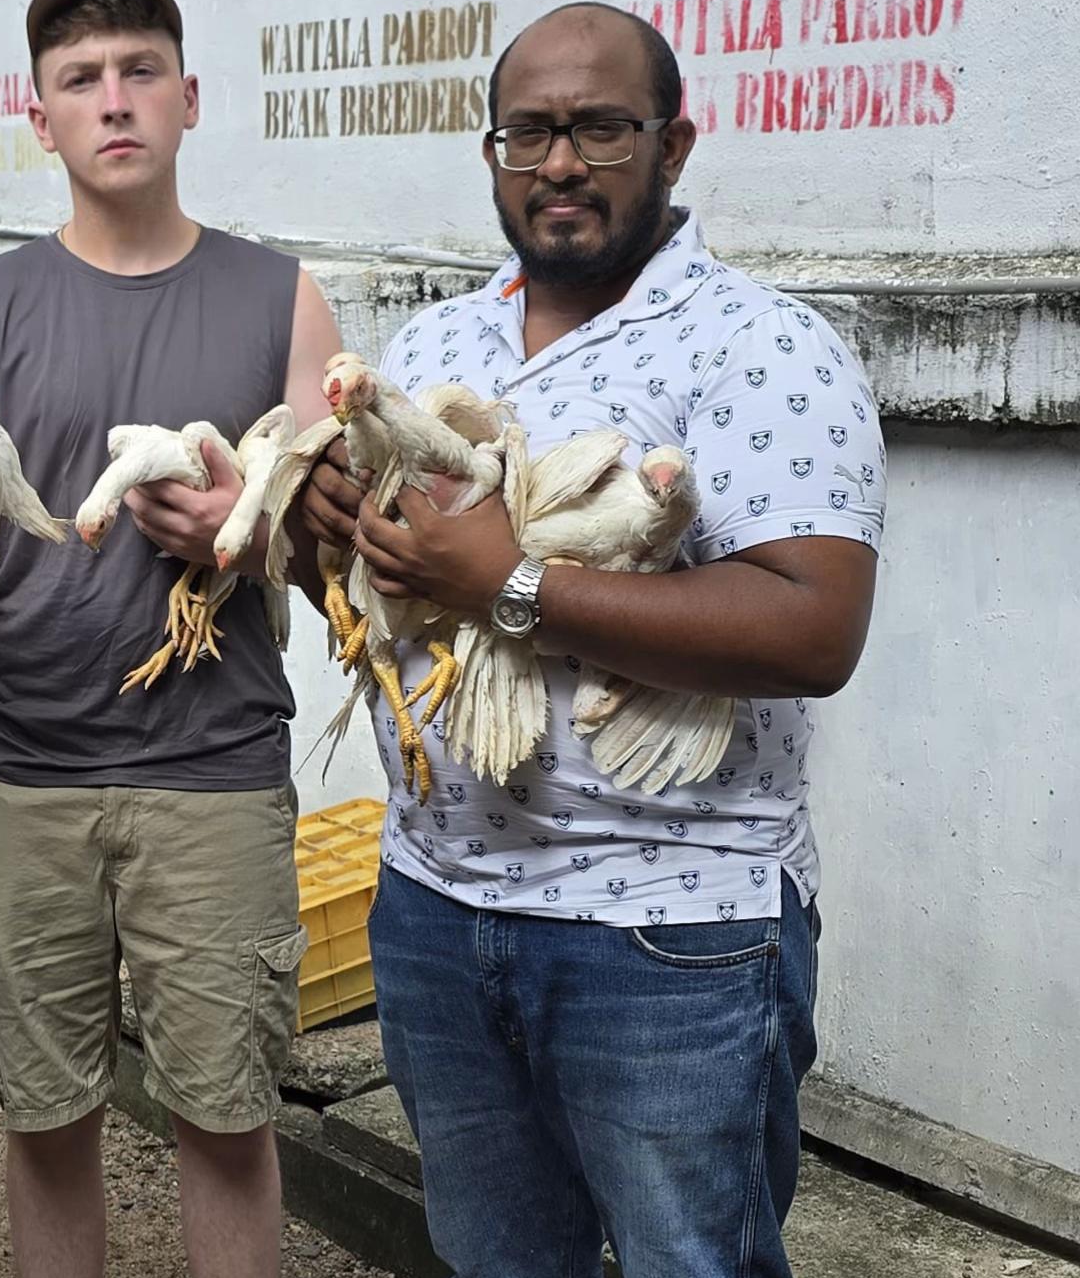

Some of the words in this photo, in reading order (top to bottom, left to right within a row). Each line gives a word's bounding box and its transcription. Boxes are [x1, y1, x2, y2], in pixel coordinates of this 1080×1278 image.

[261, 16, 372, 76] WATTALA
[381, 1, 496, 66] PARROT
[264, 87, 330, 139] BEAK
[340, 76, 486, 137] BREEDERS
[735, 60, 956, 132] BREEDERS
